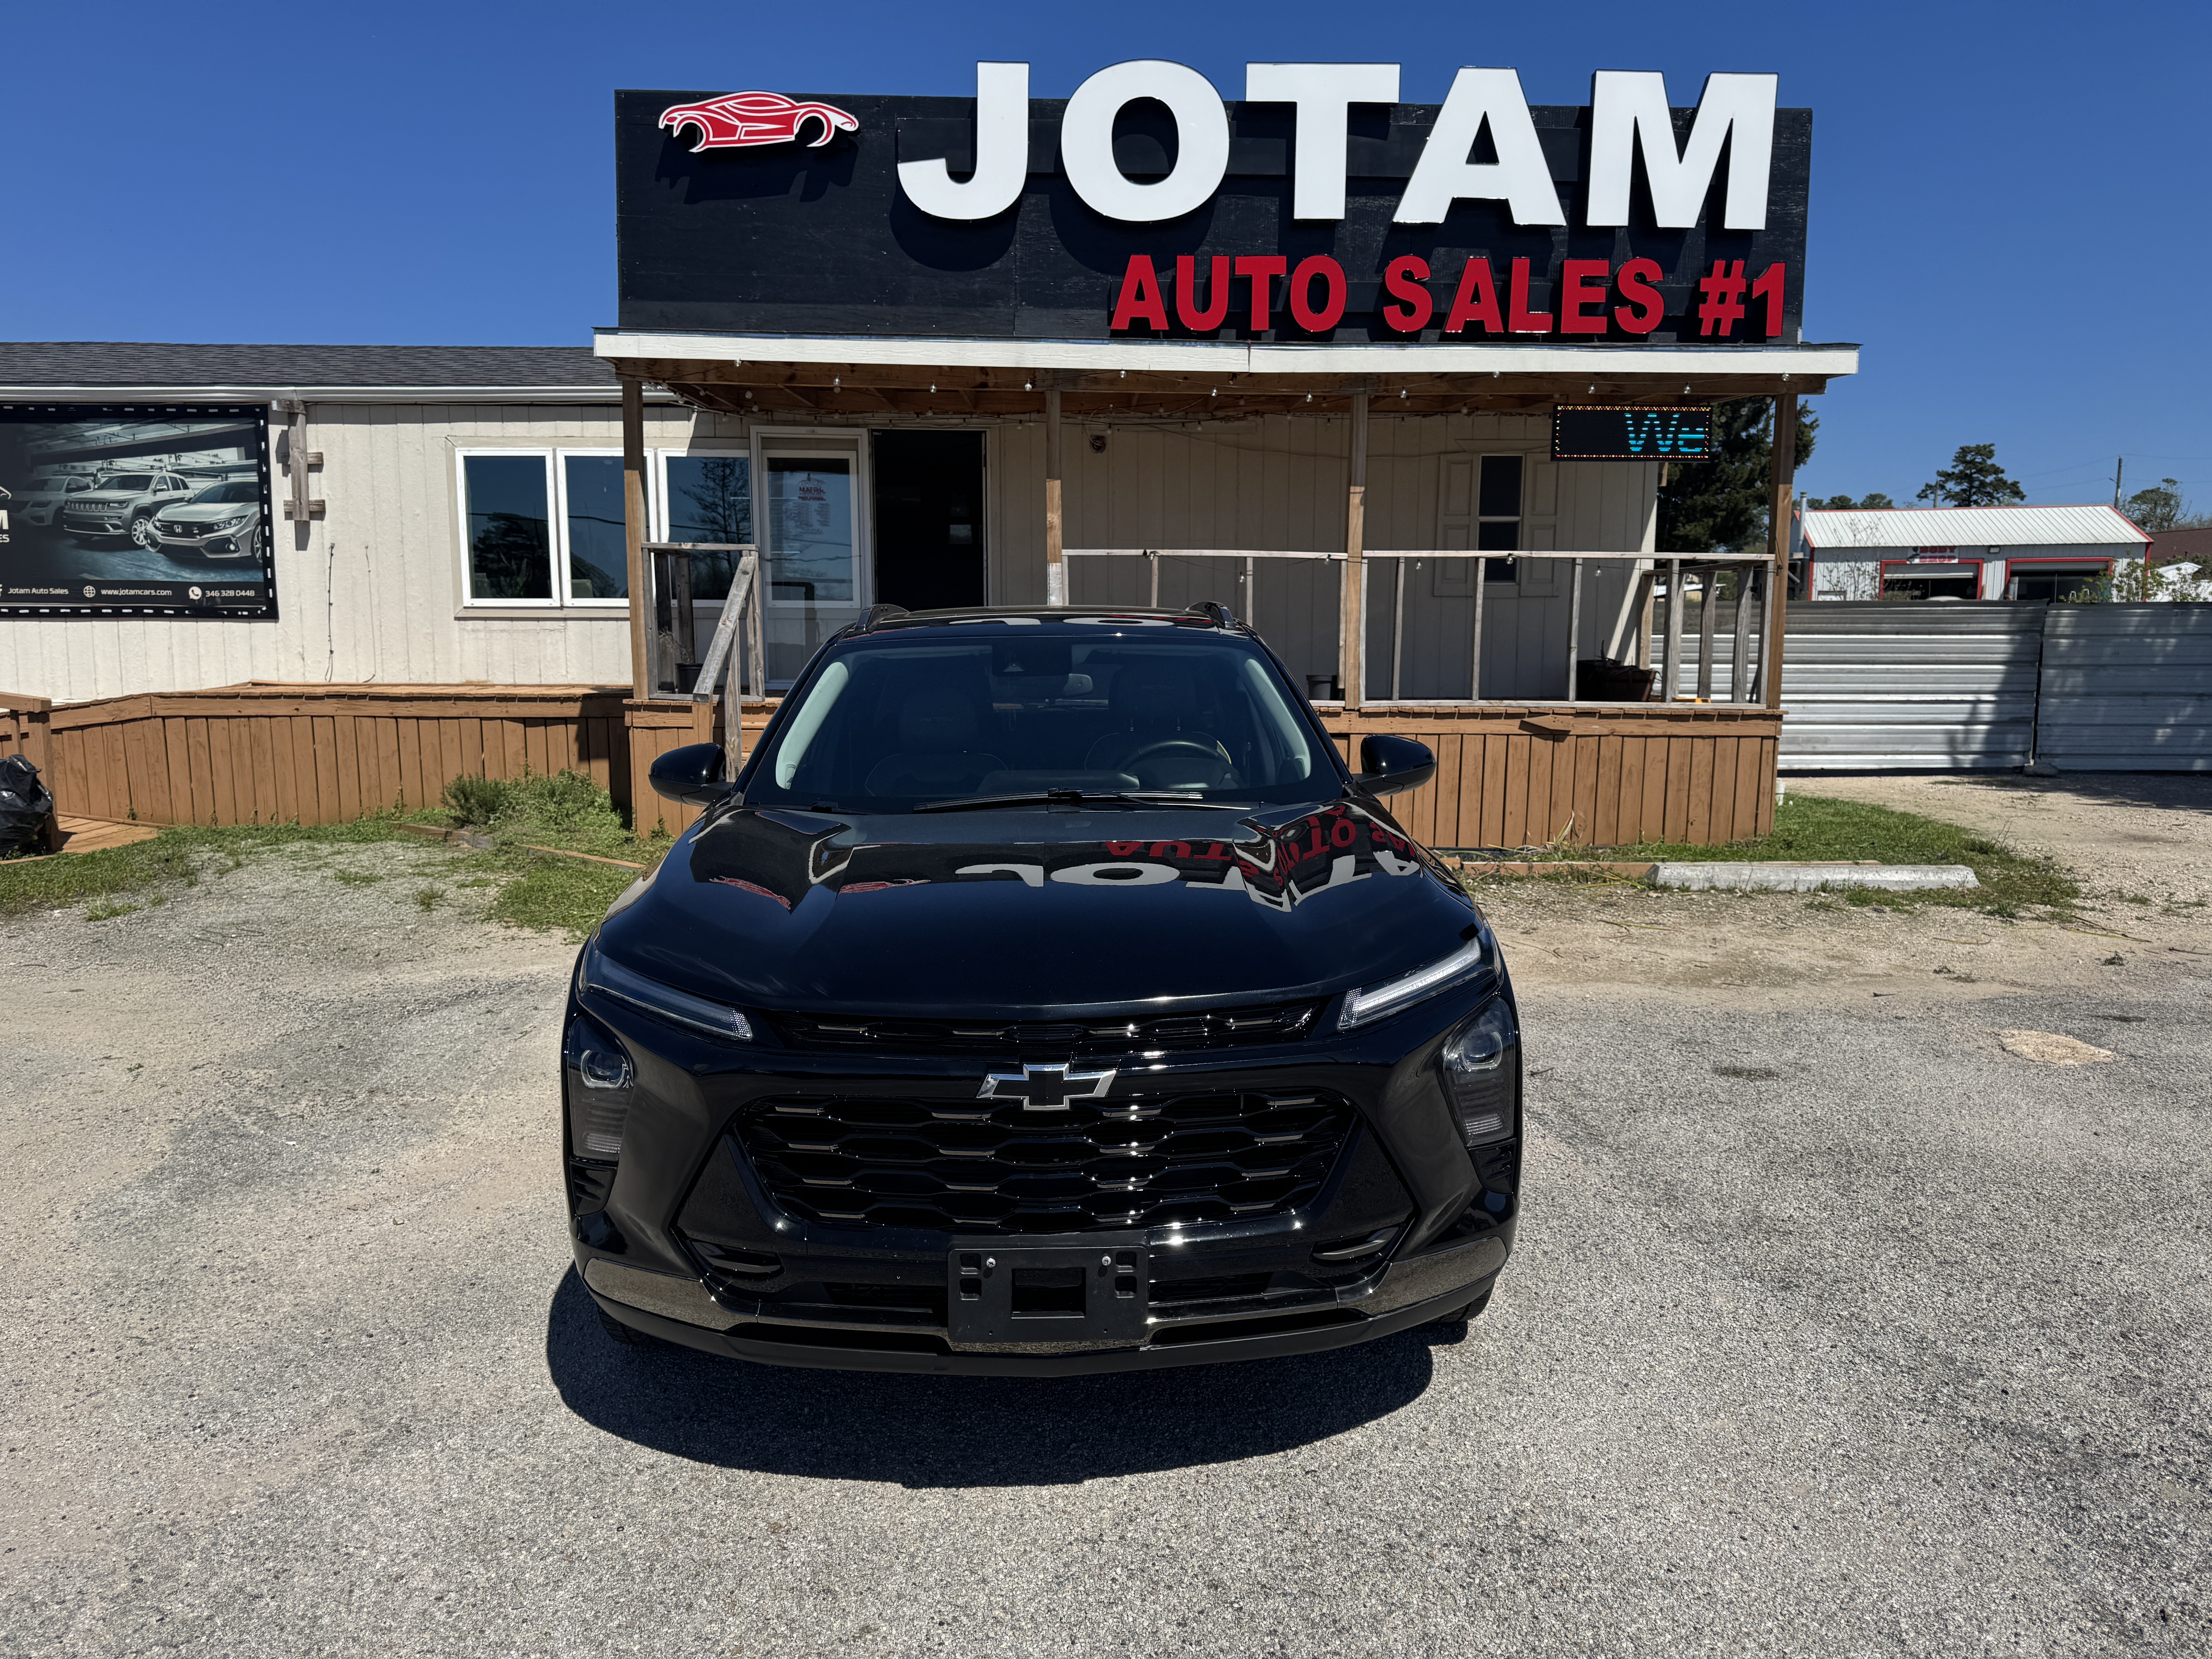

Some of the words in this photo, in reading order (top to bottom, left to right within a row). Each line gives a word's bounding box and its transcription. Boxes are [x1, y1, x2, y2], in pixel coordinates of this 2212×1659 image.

[897, 58, 1779, 230] JOTAM
[1111, 254, 1347, 333] AUTO
[1384, 254, 1665, 334] SALES
[1698, 259, 1786, 337] #1
[1625, 413, 1705, 452] We
